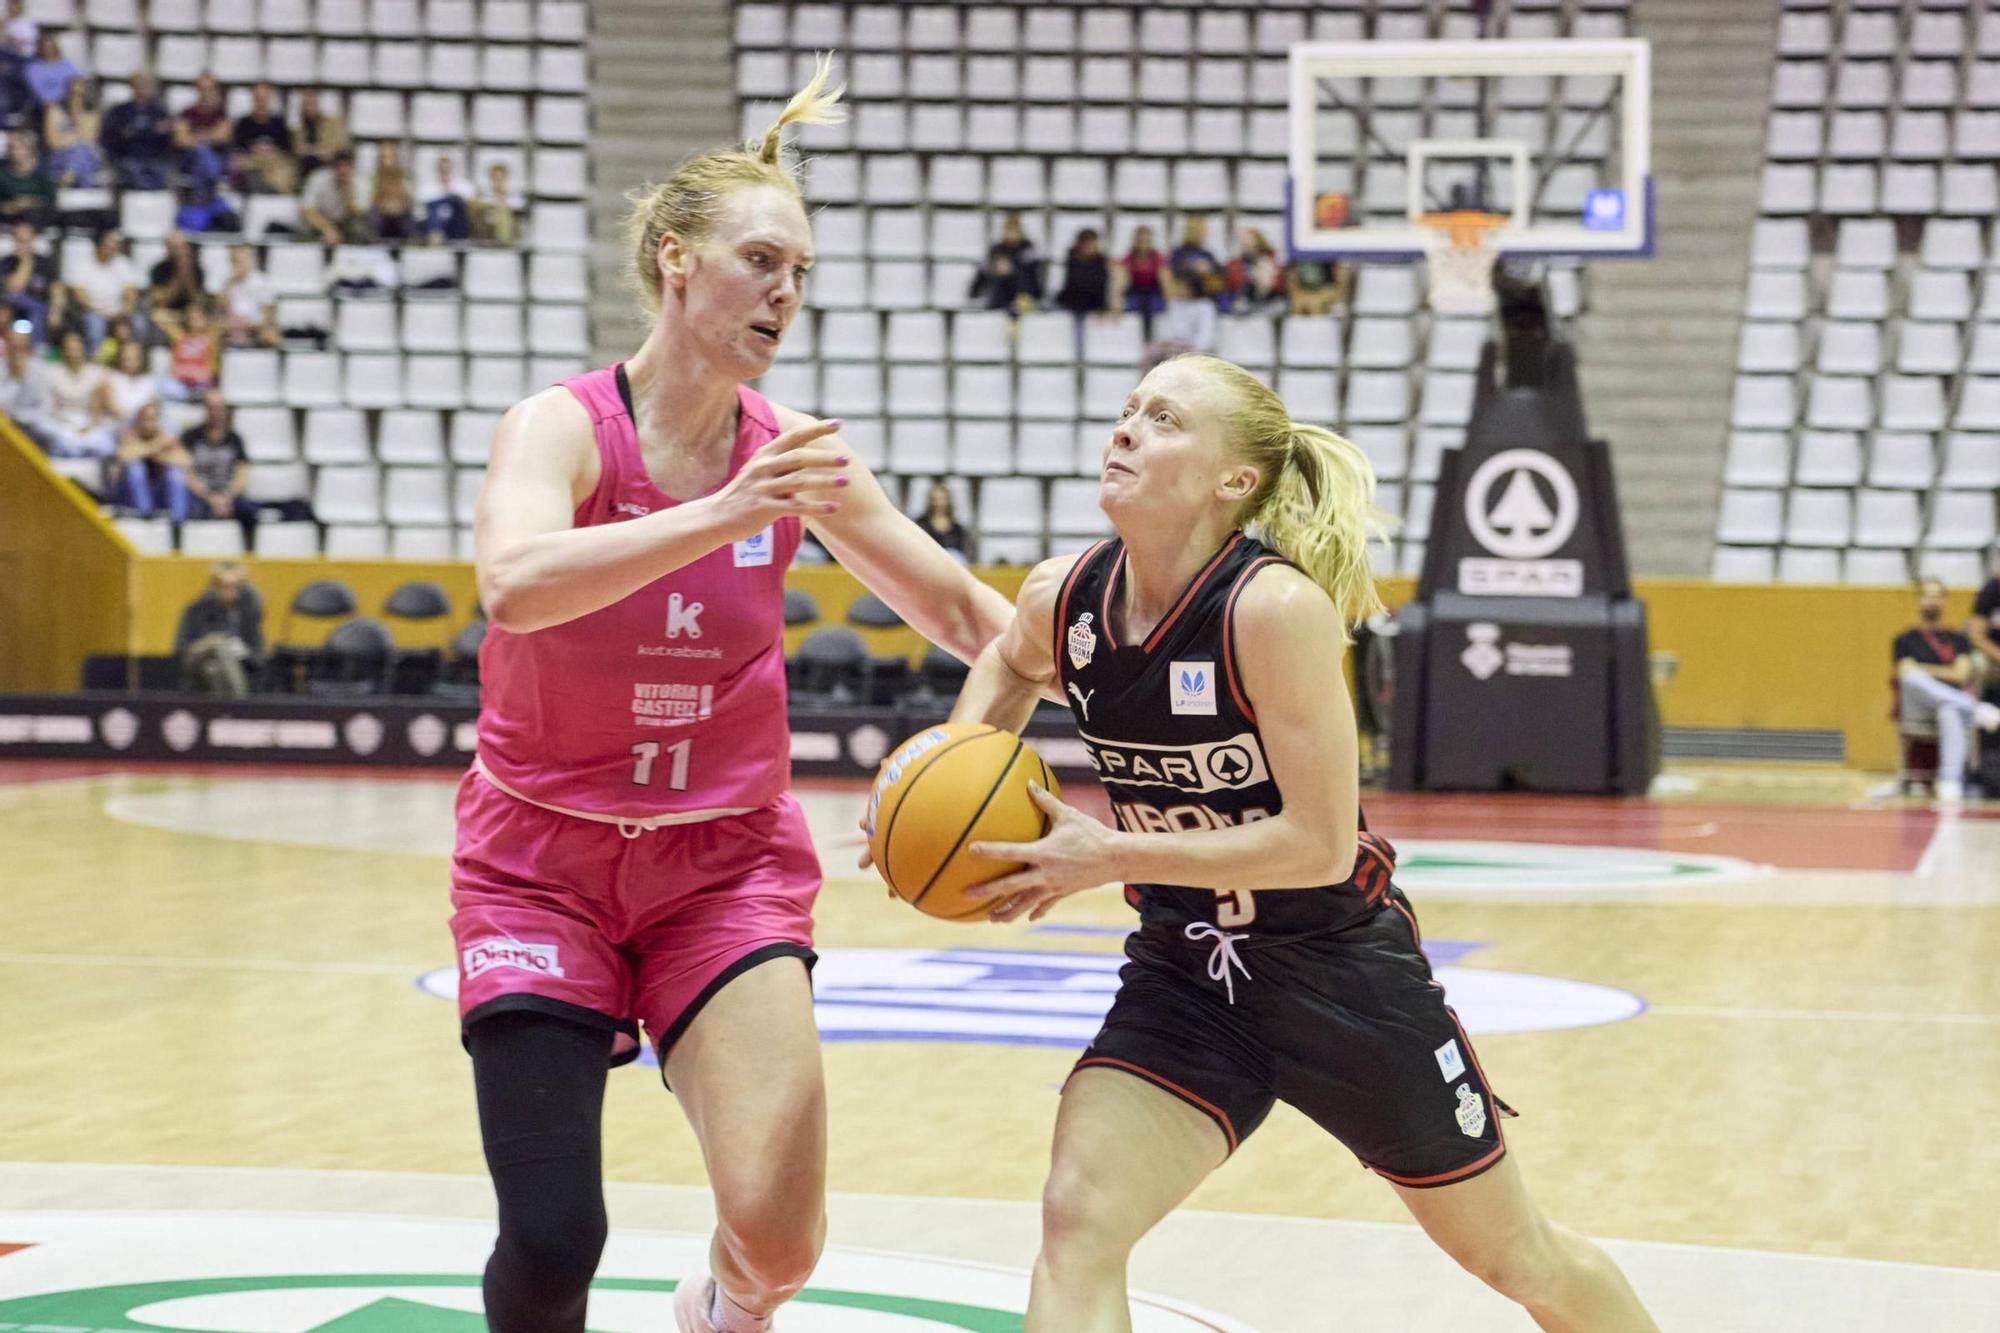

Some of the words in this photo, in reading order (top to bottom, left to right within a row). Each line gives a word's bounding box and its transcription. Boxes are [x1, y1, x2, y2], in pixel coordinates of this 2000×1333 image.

[638, 644, 723, 659] kutxabank
[634, 683, 699, 700] VITORIA
[632, 738, 693, 791] 11
[1082, 741, 1198, 782] SPAR
[472, 944, 550, 972] Diario
